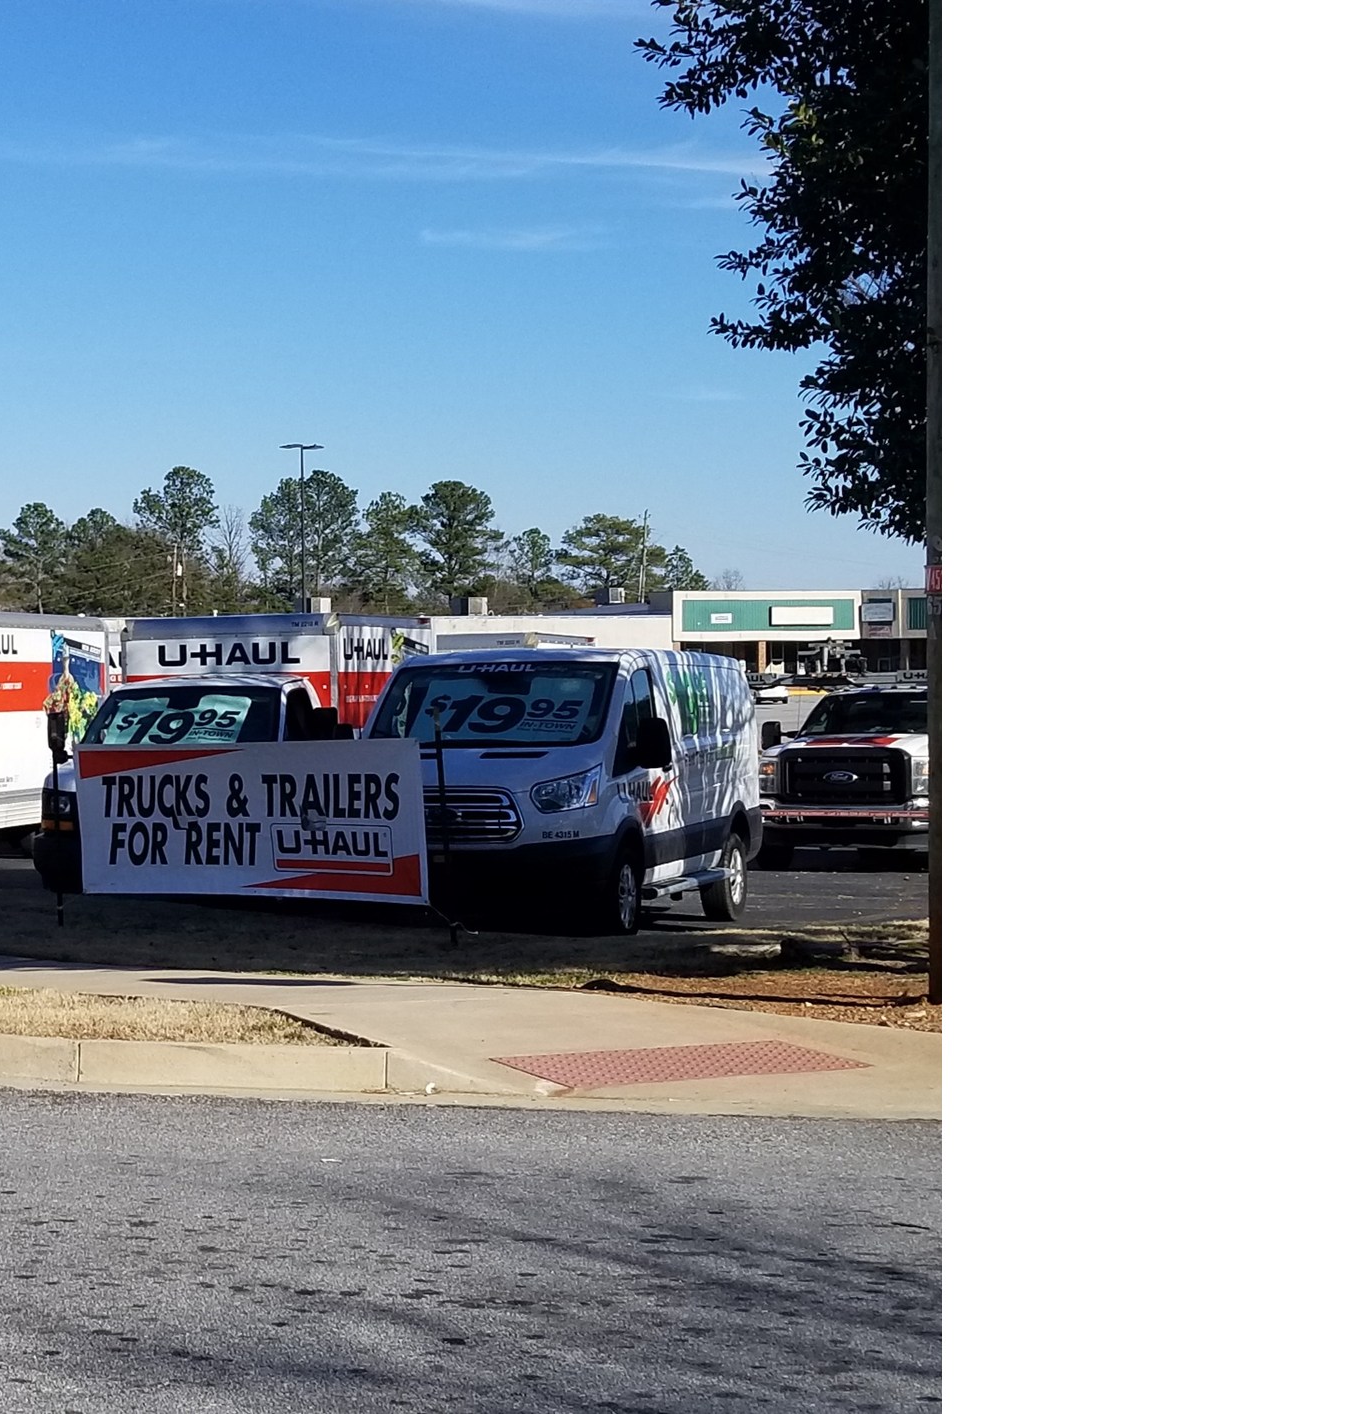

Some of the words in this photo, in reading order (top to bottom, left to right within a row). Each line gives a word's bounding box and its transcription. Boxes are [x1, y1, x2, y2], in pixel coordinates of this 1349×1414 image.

[158, 642, 300, 667] U-HAUL
[343, 637, 388, 660] U-HAUL
[458, 664, 537, 673] U-HAUL
[188, 729, 235, 738] IN-TOWN
[101, 774, 210, 818] TRUCKS
[226, 774, 250, 818] &
[260, 772, 400, 821] TRAILERS
[109, 822, 169, 865] FOR
[184, 822, 261, 866] RENT
[276, 829, 389, 857] U-HAUL
[542, 831, 553, 839] BE
[573, 830, 580, 838] M
